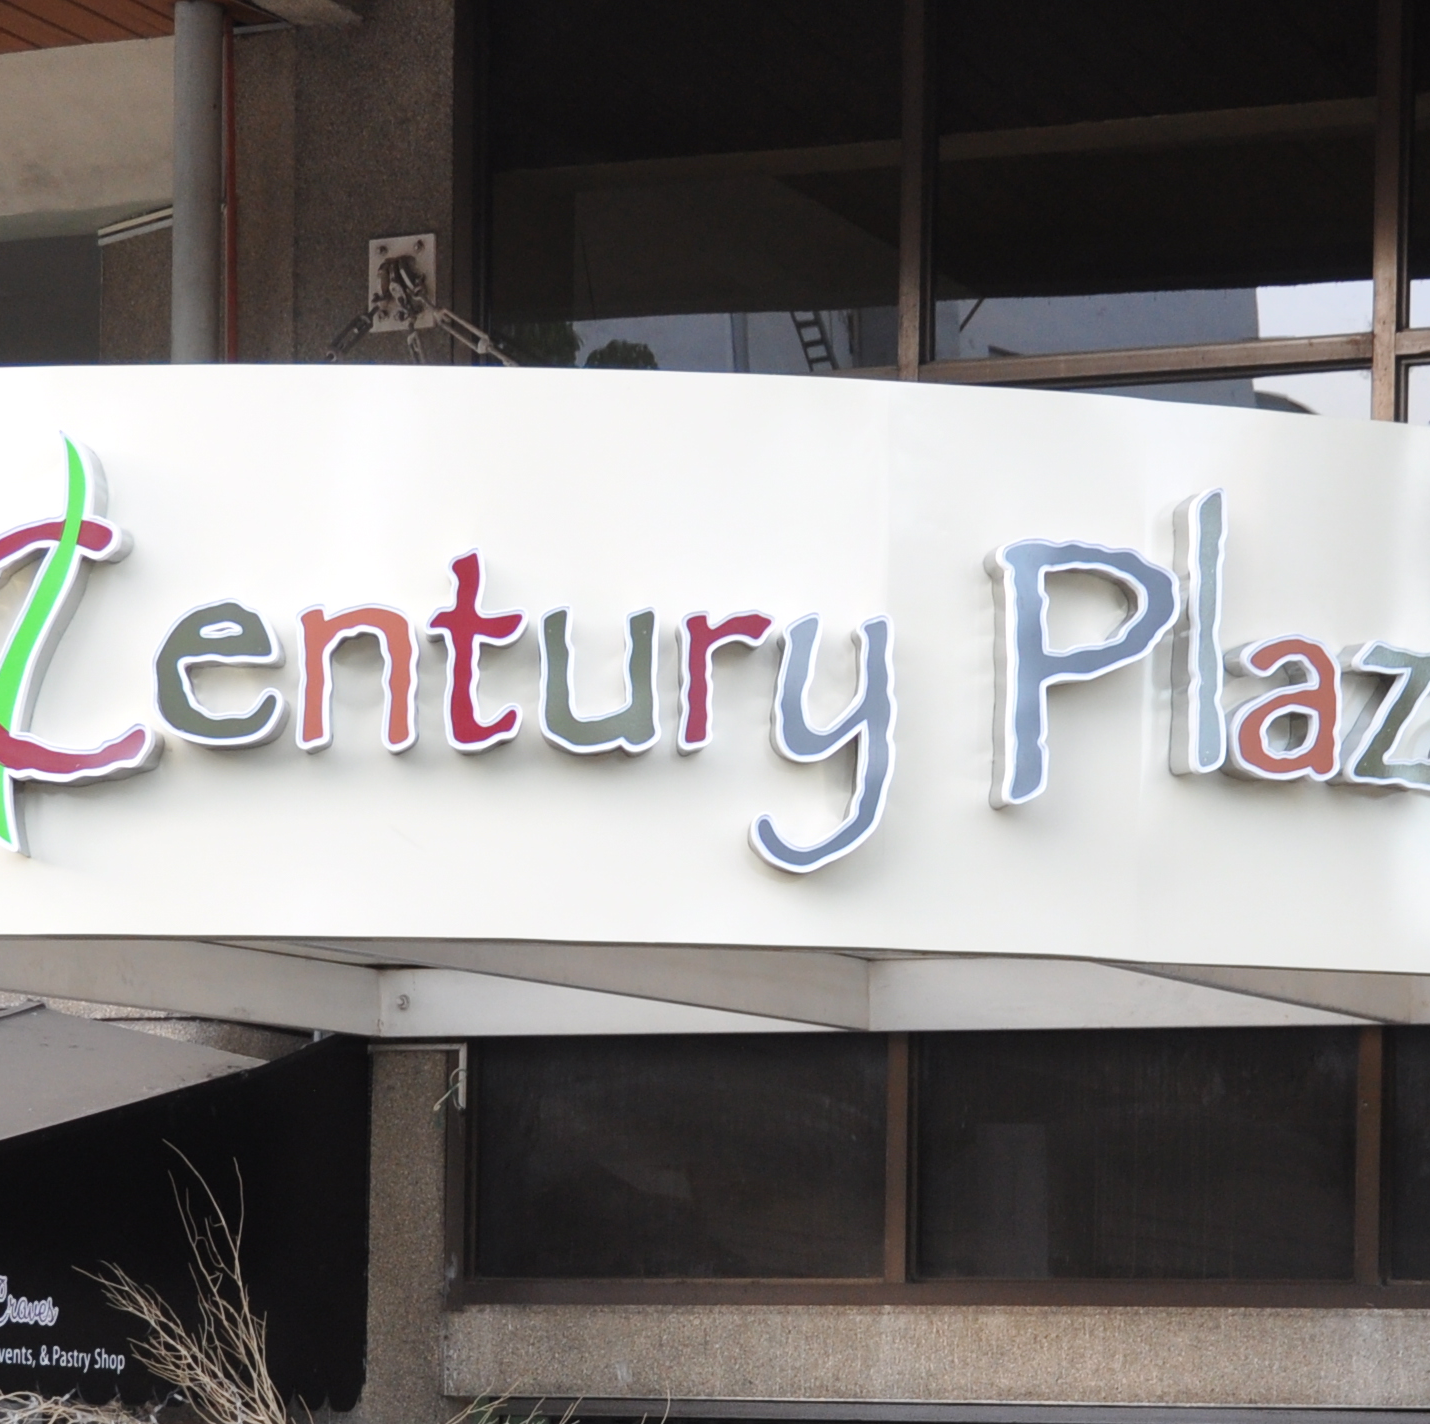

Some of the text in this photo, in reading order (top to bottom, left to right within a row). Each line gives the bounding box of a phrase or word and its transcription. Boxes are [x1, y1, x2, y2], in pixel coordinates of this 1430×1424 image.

[39, 1344, 50, 1366] &
[52, 1345, 91, 1373] Pastry
[94, 1348, 126, 1374] Shop
